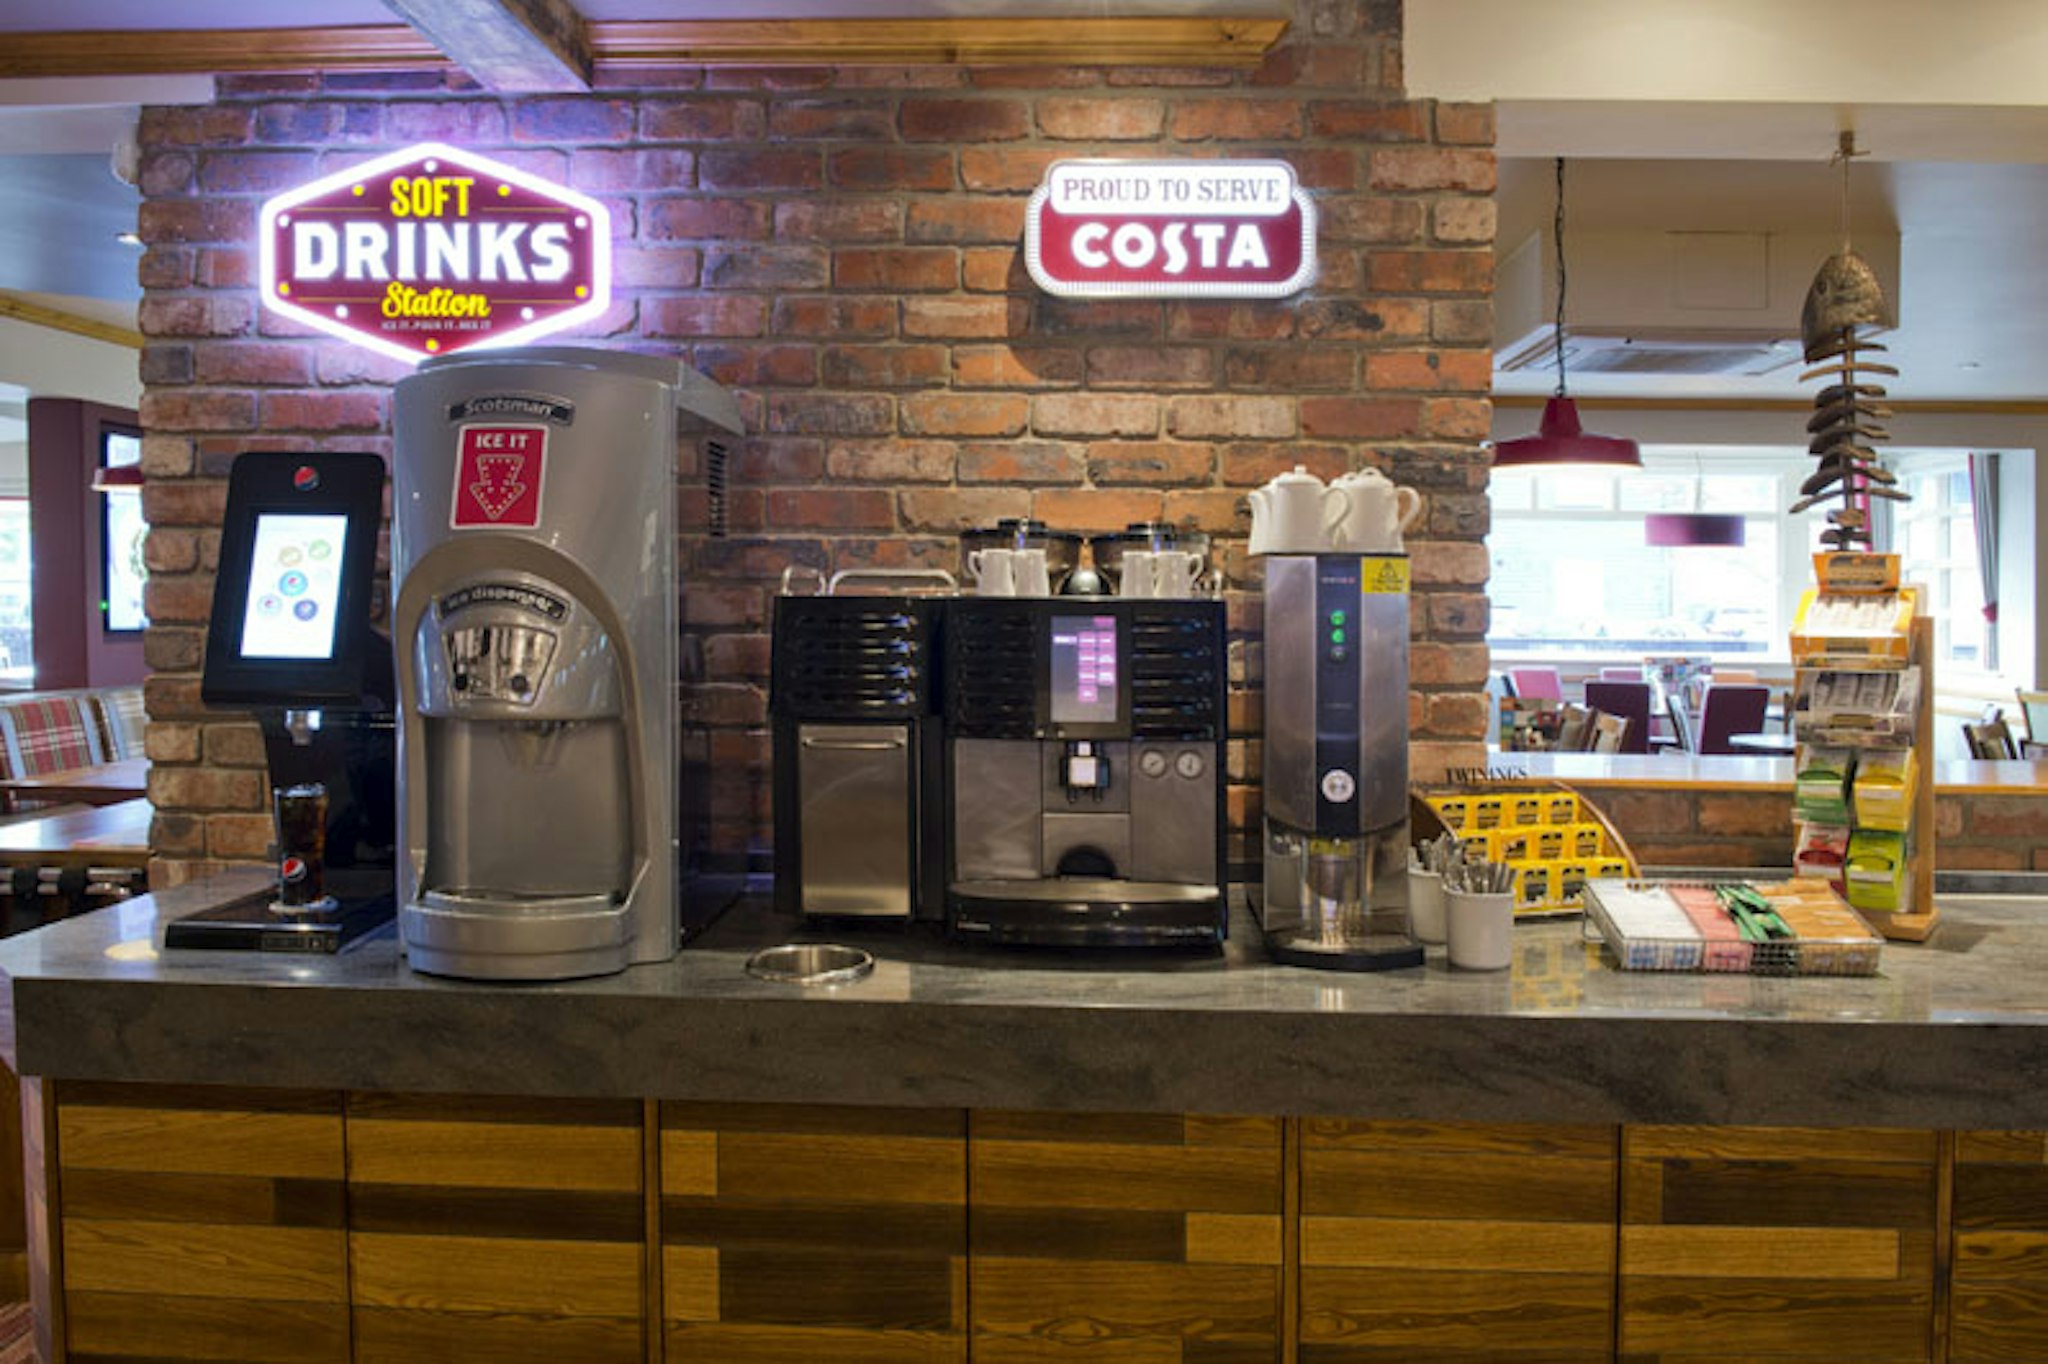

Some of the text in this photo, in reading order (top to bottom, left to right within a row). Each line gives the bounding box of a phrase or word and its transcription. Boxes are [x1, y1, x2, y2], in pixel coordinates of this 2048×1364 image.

[390, 176, 475, 217] SOFT
[1062, 178, 1280, 202] PROUD TO SERVE
[293, 221, 572, 282] DRINKS
[1070, 221, 1270, 275] COSTA
[381, 280, 491, 318] Station
[464, 400, 552, 417] Scotsman
[475, 432, 529, 449] ICE IT
